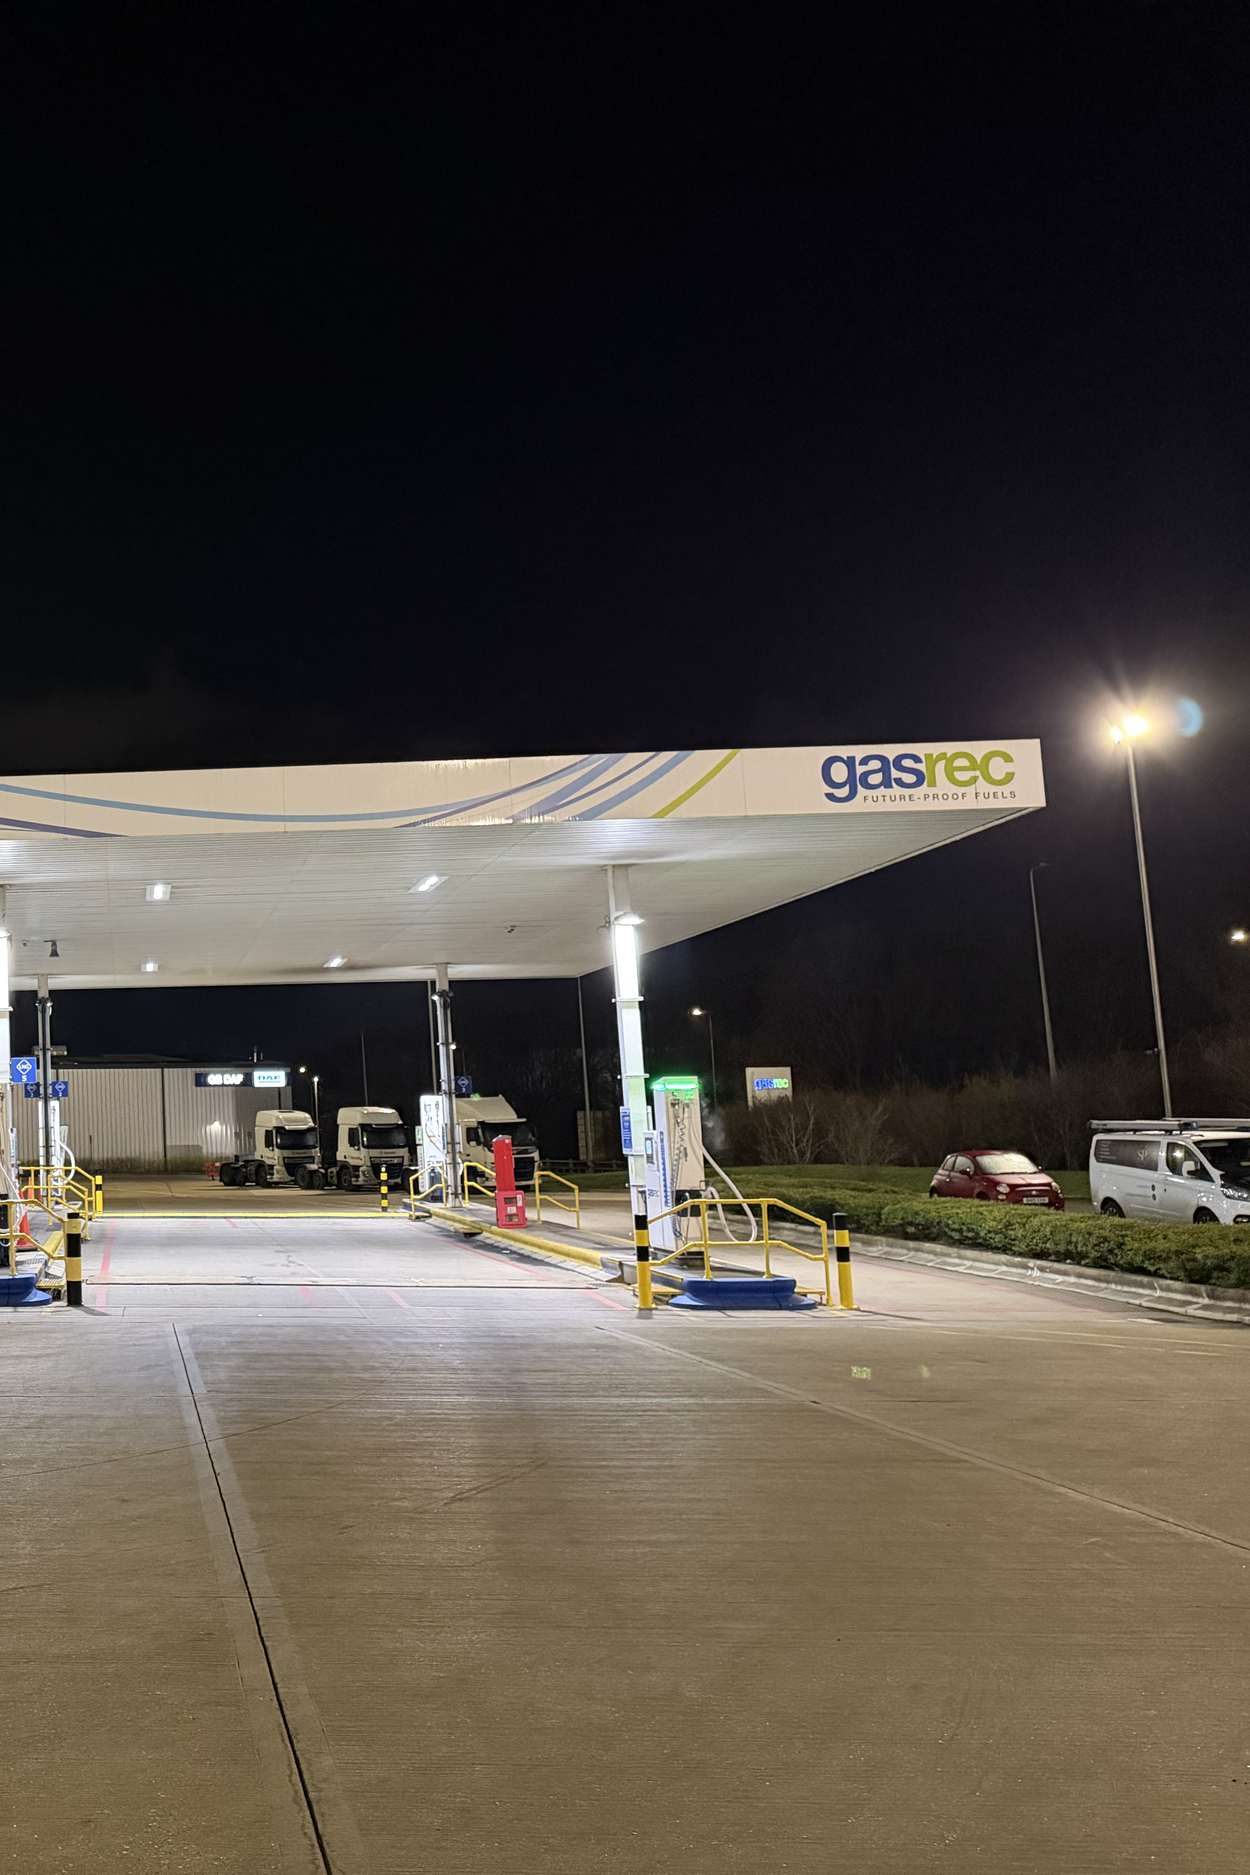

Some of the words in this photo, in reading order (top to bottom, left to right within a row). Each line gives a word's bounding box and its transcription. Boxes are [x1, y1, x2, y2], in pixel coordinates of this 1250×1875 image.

[821, 750, 1016, 804] gasrec
[863, 792, 968, 803] FUTURE-PROOF
[975, 790, 1017, 800] FUELS
[223, 1074, 243, 1085] DAF
[754, 1078, 789, 1091] gasrec
